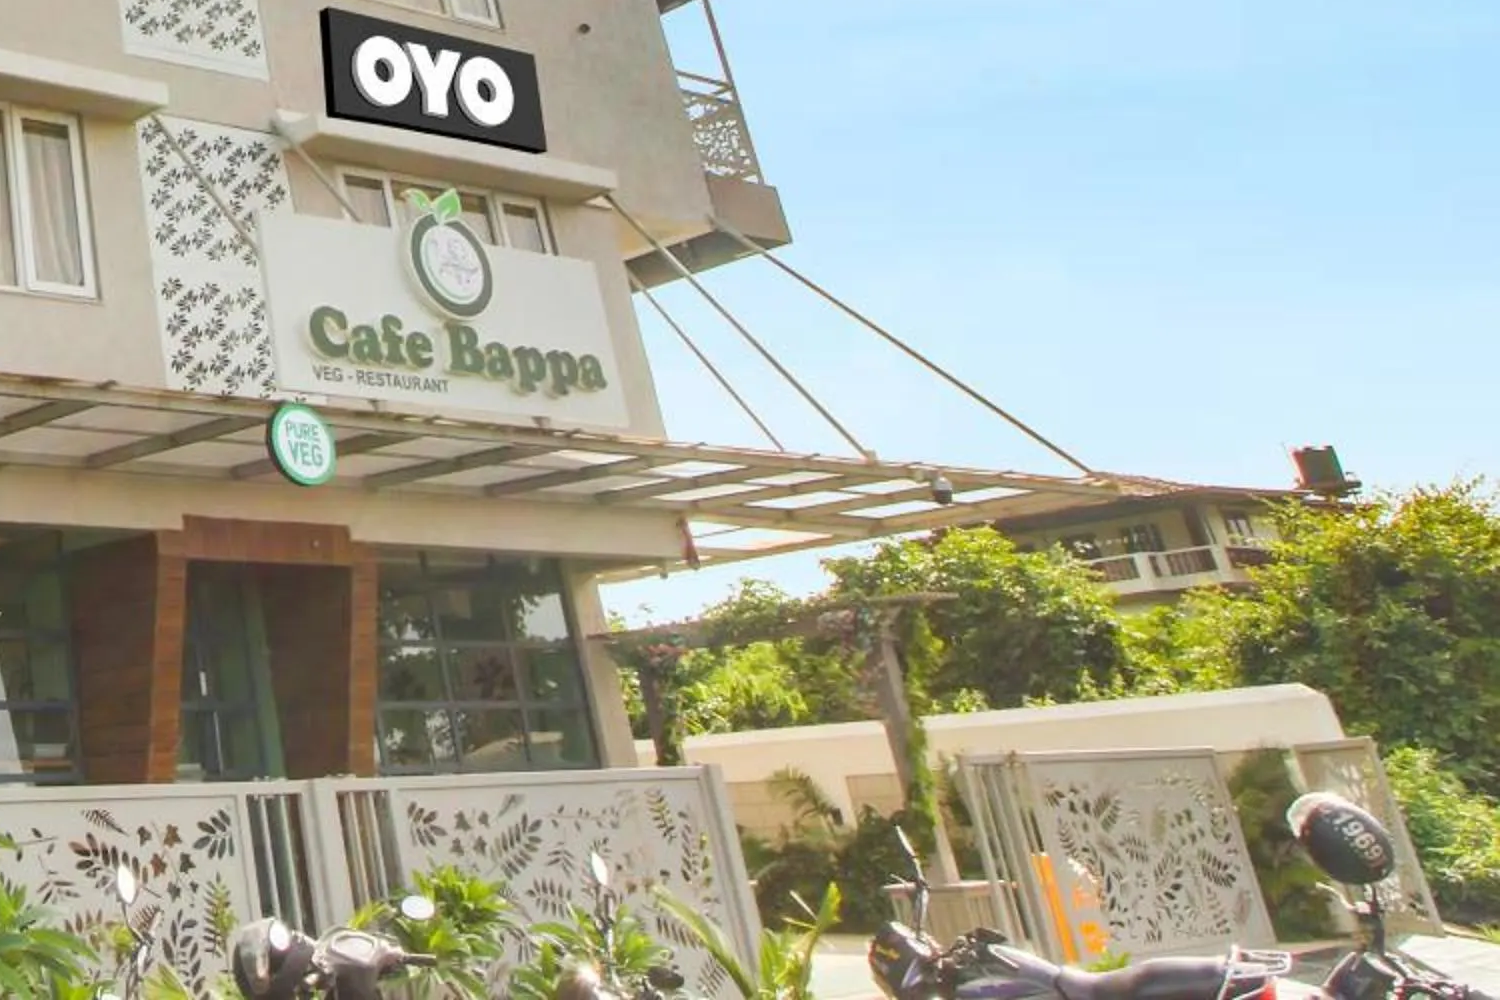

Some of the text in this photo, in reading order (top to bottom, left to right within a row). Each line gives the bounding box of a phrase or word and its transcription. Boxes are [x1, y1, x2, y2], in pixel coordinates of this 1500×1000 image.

[352, 35, 515, 127] OYO
[309, 305, 608, 397] Cafe Bappa
[312, 364, 343, 382] VEG
[356, 369, 449, 393] RESTAURANT
[285, 419, 320, 440] PURE
[288, 439, 323, 467] VEG
